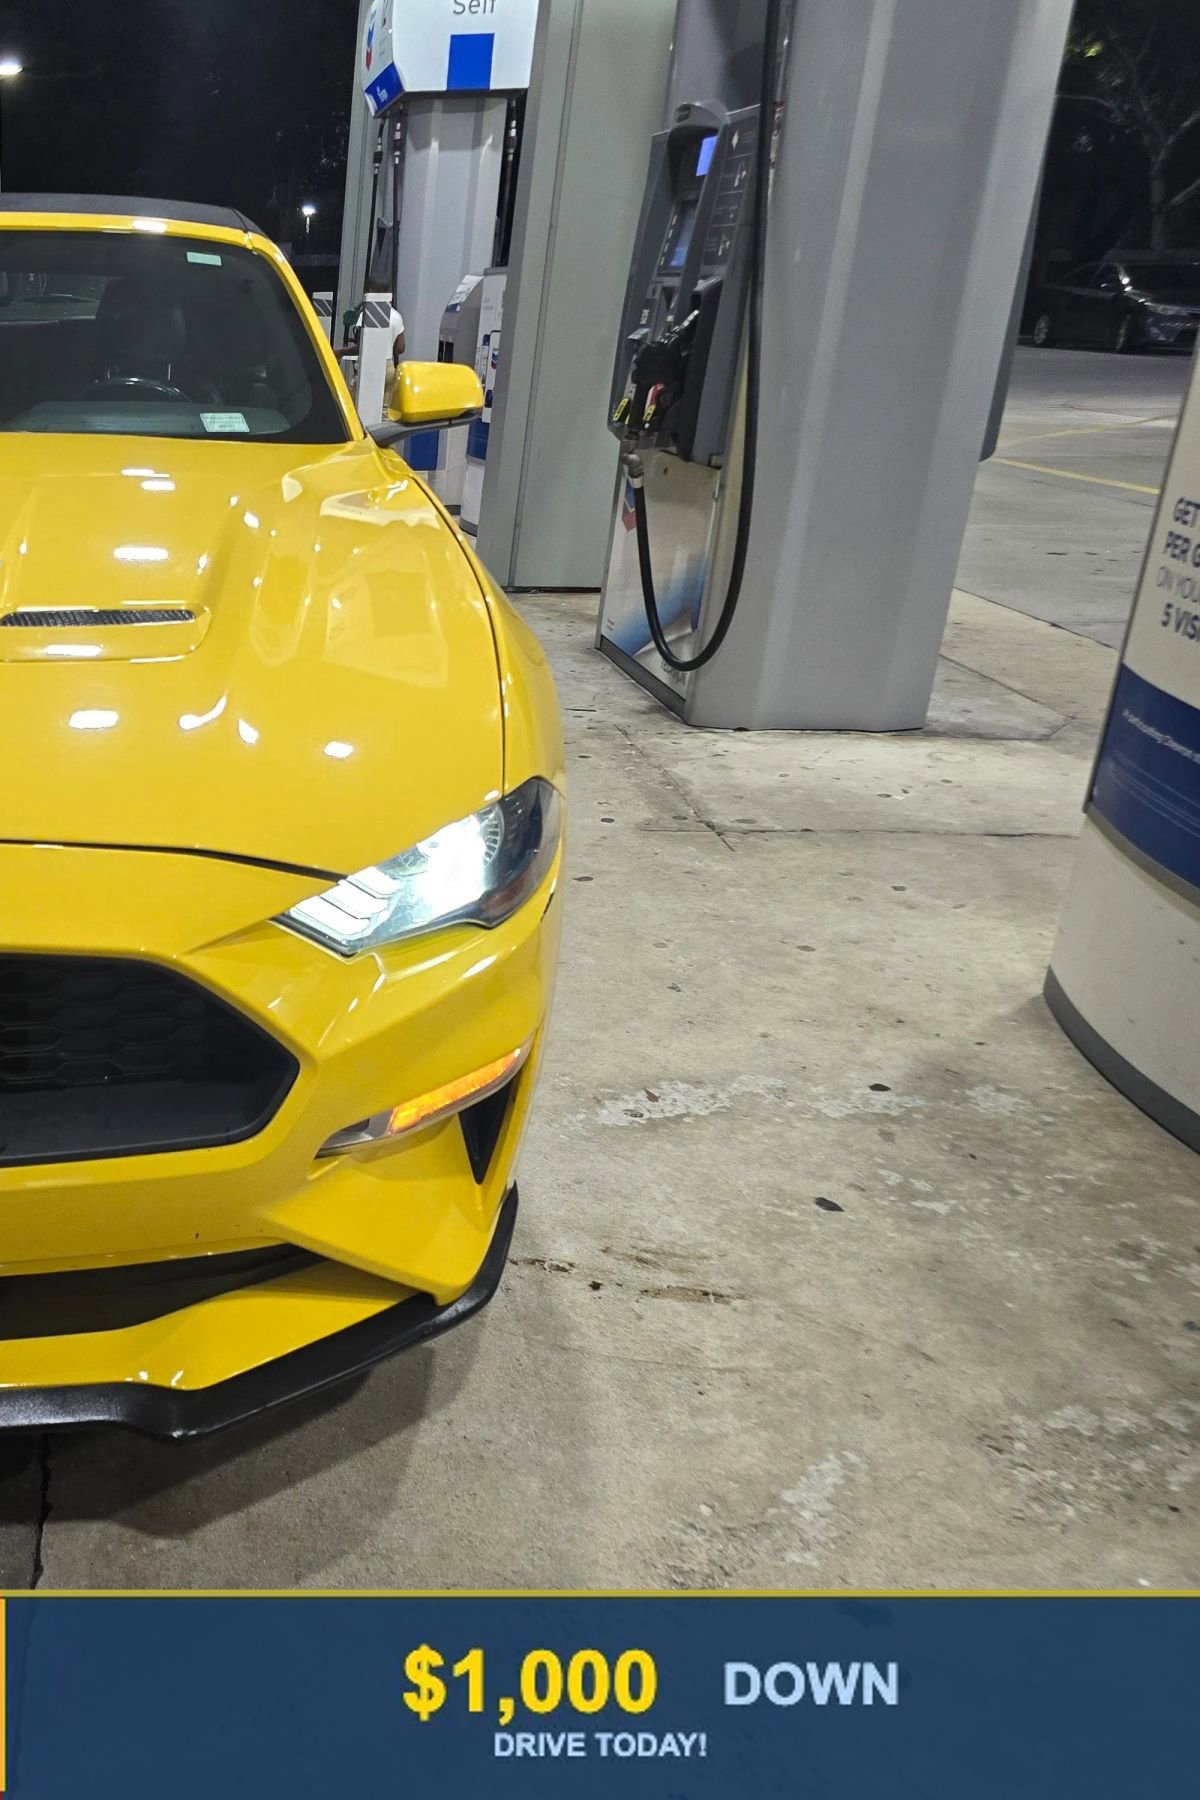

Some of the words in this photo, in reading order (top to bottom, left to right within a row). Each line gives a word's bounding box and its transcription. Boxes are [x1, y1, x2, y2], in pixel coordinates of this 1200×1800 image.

[452, 0, 496, 15] Self
[1163, 530, 1191, 563] PER
[1156, 565, 1174, 591] ON
[1161, 602, 1173, 628] 5
